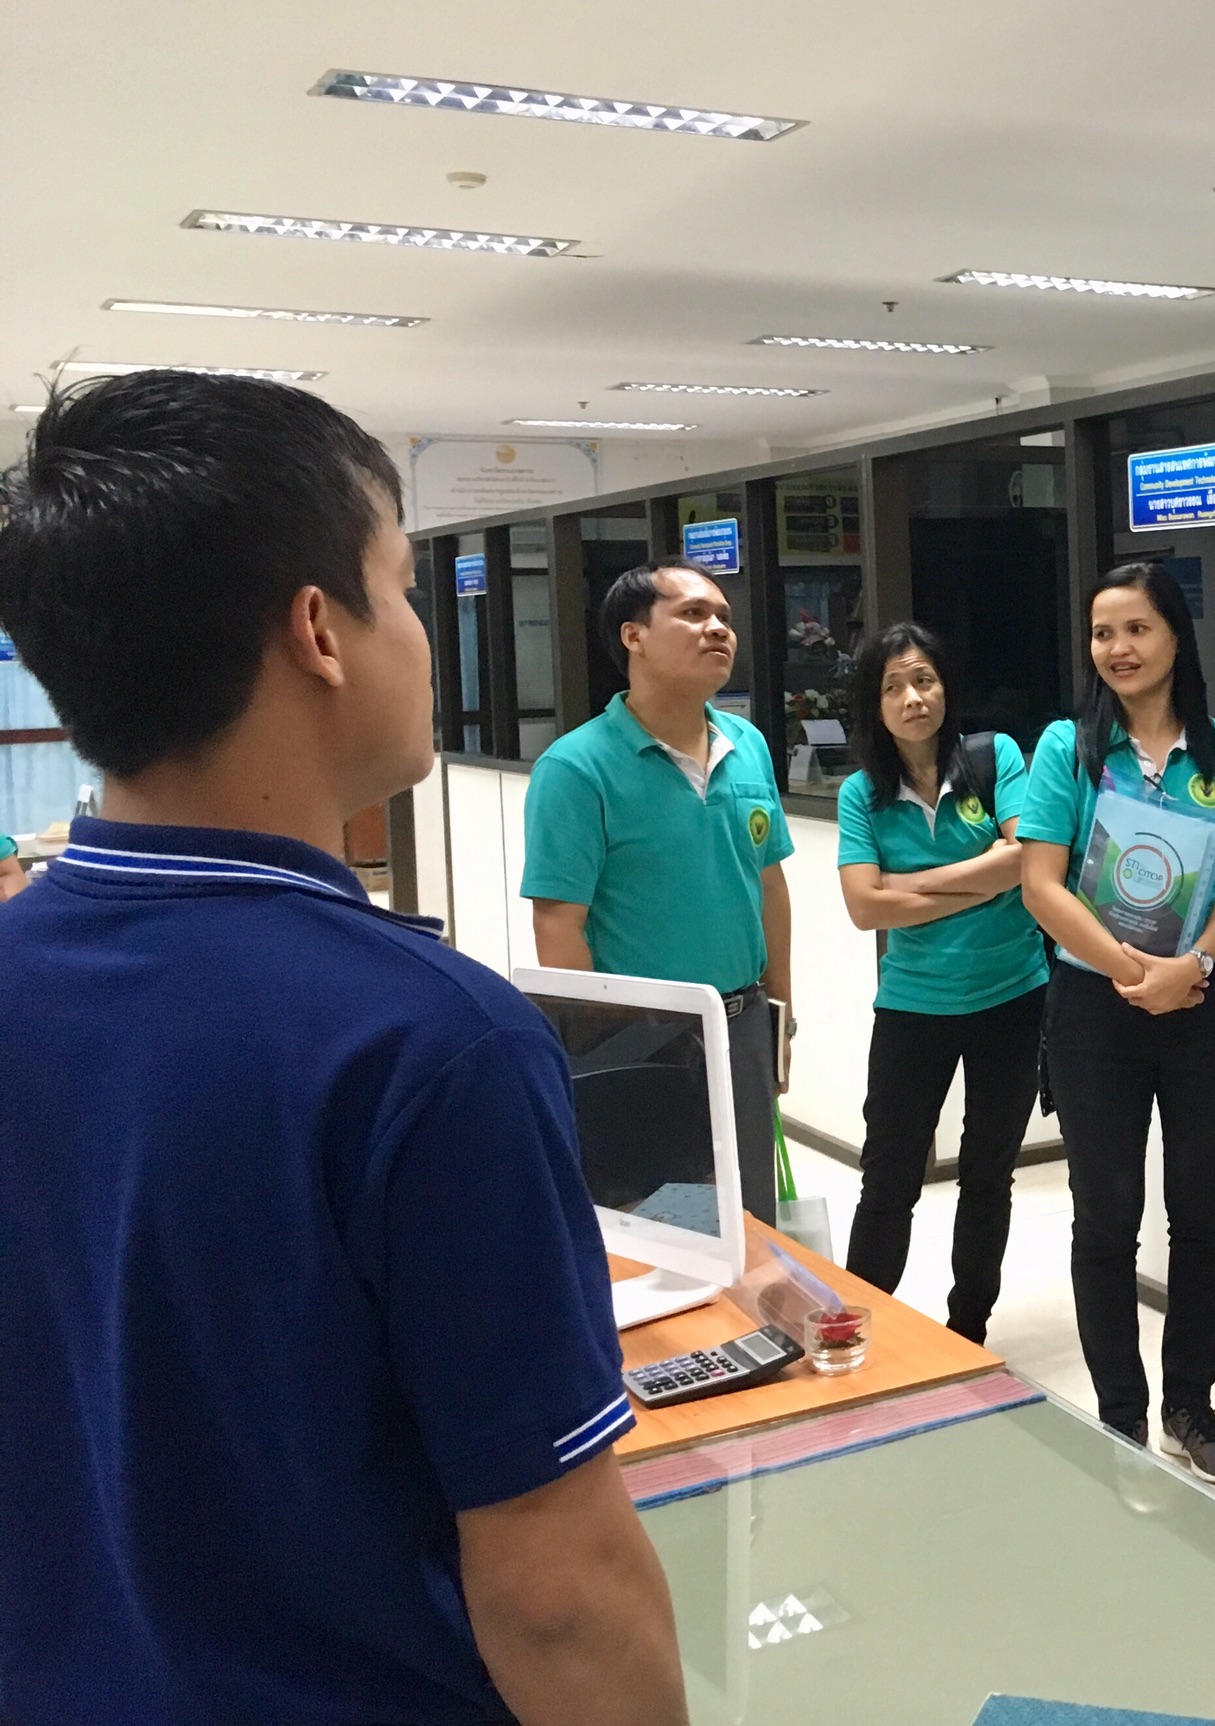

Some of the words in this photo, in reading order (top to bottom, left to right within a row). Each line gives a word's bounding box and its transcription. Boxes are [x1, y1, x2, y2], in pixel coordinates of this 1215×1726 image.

[1140, 481, 1164, 490] Community
[1165, 478, 1194, 488] Development
[1125, 858, 1139, 870] STI
